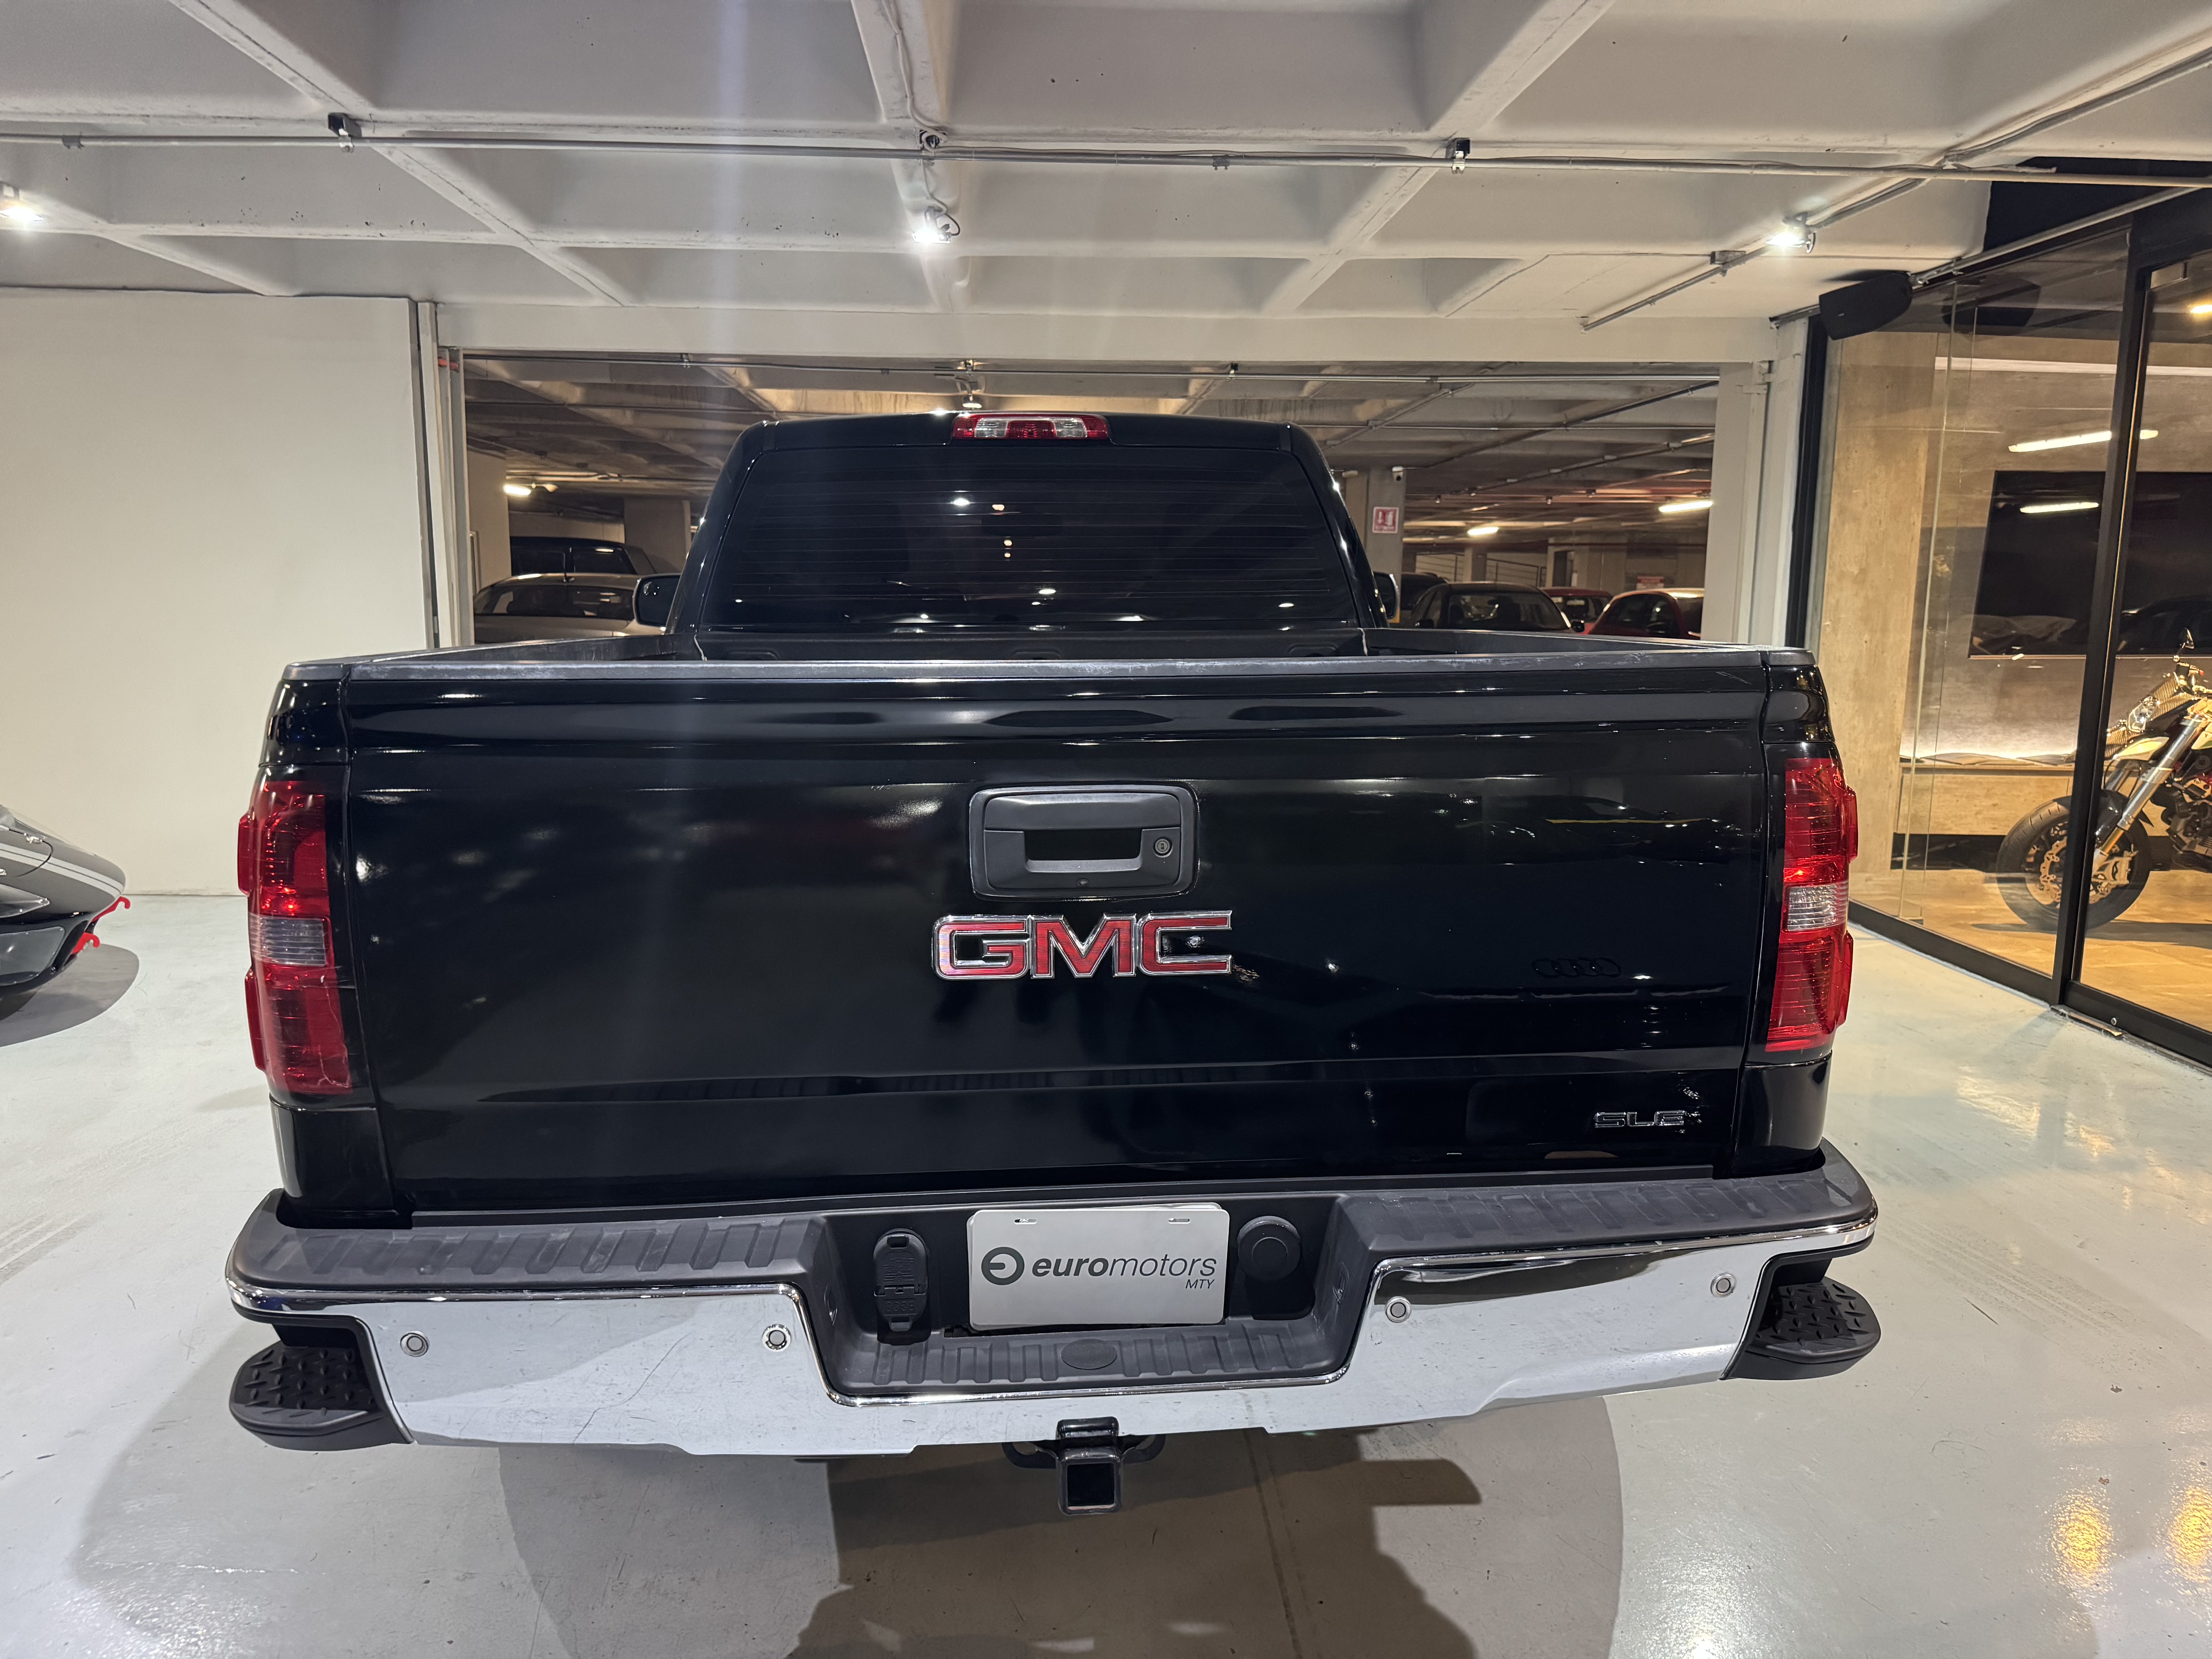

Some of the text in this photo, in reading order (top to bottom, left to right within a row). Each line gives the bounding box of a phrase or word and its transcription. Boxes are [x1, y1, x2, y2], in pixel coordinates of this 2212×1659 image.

[932, 910, 1232, 980] GMC
[1594, 1110, 1684, 1128] SLE
[1032, 1254, 1217, 1277] euromotors
[1185, 1279, 1214, 1289] MTY
